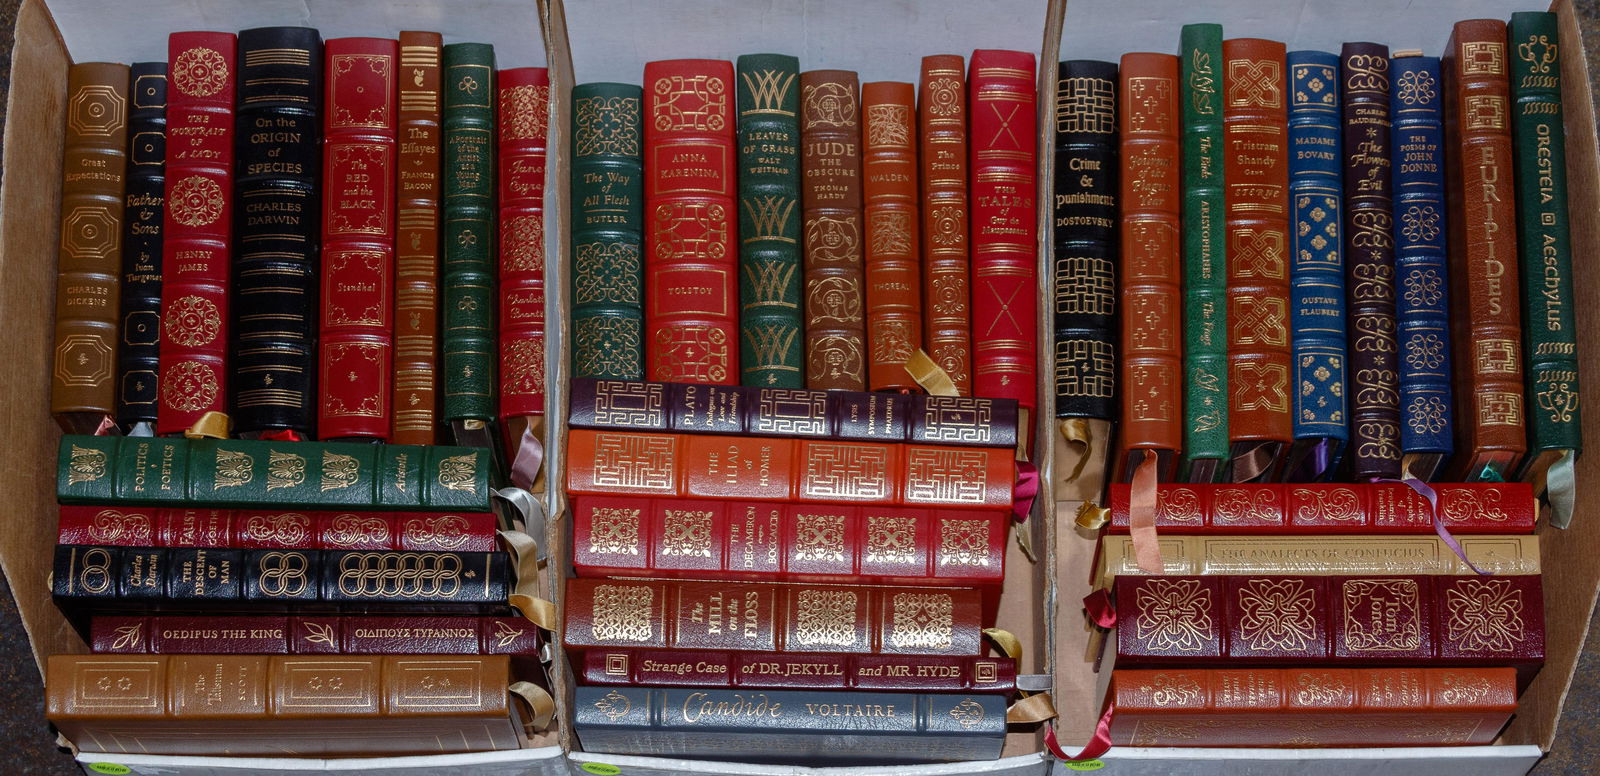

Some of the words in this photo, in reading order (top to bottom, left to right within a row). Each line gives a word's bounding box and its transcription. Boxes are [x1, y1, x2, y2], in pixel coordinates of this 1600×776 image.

[188, 115, 209, 123] THE
[1356, 109, 1387, 117] CHARLES
[256, 118, 272, 127] On
[277, 118, 296, 127] the
[171, 128, 226, 136] PORTRAIT
[251, 133, 301, 143] ORIGIN
[408, 128, 428, 139] The
[749, 132, 788, 141] LEAVES
[191, 138, 203, 146] OF
[1200, 136, 1212, 154] The
[1232, 140, 1278, 152] Tristram
[1358, 141, 1382, 153] The
[176, 150, 186, 158] A
[190, 150, 222, 159] LADY
[268, 148, 281, 157] of
[743, 145, 756, 154] OF
[762, 145, 796, 154] GRASS
[806, 143, 855, 157] JUDE
[937, 151, 954, 159] The
[672, 154, 707, 163] ANNA
[1237, 155, 1276, 167] Shandy
[1297, 152, 1335, 160] BOVARY
[1350, 153, 1390, 167] Flowers
[1404, 153, 1432, 162] JOHN
[82, 158, 106, 168] Great
[248, 163, 302, 174] SPECIES
[352, 159, 367, 170] The
[509, 160, 544, 174] Jane
[932, 162, 960, 170] Prince
[1069, 157, 1101, 171] Crime
[1200, 156, 1213, 179] Birds
[1401, 164, 1437, 173] DONNE
[1536, 123, 1553, 204] ORESTEIA
[66, 172, 121, 183] Expectations
[346, 174, 369, 182] RED
[401, 171, 435, 179] FRANCIS
[584, 172, 602, 184] The
[608, 172, 630, 184] Way
[661, 168, 719, 178] KARENINA
[807, 169, 855, 177] OBSCURE
[870, 174, 909, 182] WALDEN
[1368, 167, 1380, 180] of
[404, 182, 432, 190] BACON
[509, 176, 544, 195] Eyre
[1080, 174, 1093, 187] &
[1358, 179, 1382, 191] Evil
[344, 185, 359, 195] and
[361, 185, 373, 195] the
[601, 182, 612, 193] of
[1234, 188, 1280, 199] STERNE
[126, 192, 165, 207] Father
[340, 200, 376, 209] BLACK
[583, 196, 599, 206] All
[604, 195, 630, 206] Flesh
[978, 196, 1031, 208] TALES
[246, 203, 301, 212] CHARLES
[1001, 207, 1009, 216] of
[248, 216, 299, 226] DARWIN
[586, 216, 627, 224] BUTLER
[991, 216, 1007, 225] Guy
[1057, 217, 1113, 228] DOSTOEVSKY
[132, 222, 159, 235] Sons
[1479, 147, 1504, 316] EURIPIDES
[1201, 200, 1211, 280] ARISTOPHANES
[141, 252, 149, 262] by
[176, 250, 212, 259] HENRY
[178, 264, 208, 274] JAMES
[67, 286, 108, 295] CHARLES
[338, 282, 375, 292] Stendhal
[668, 287, 713, 295] TOLSTOY
[873, 282, 911, 290] THOREAU
[66, 298, 106, 306] DICKENS
[1203, 301, 1214, 319] The
[1201, 320, 1216, 346] Frogs
[684, 386, 696, 425] PLATO
[707, 396, 716, 426] Dialogues
[868, 396, 876, 435] SYMPOSIUM
[135, 442, 149, 492] POLITICS
[162, 444, 174, 490] POETICS
[709, 452, 719, 475] THE
[726, 445, 738, 484] ILIAD
[744, 459, 752, 470] of
[760, 446, 770, 487] HOMER
[396, 453, 408, 492] Aristotle
[180, 510, 196, 545] FAUST
[209, 511, 219, 545] GOETHE
[731, 523, 740, 544] THE
[744, 506, 756, 568] DECAMERON
[769, 510, 778, 564] BOCCACCIO
[1251, 549, 1317, 558] ANALECTS
[1323, 549, 1337, 558] OF
[1345, 548, 1424, 558] CONFUCIUS
[132, 554, 143, 587] Charles
[146, 554, 158, 587] Darwin
[183, 561, 192, 582] THE
[195, 550, 206, 596] DESCENT
[208, 565, 217, 578] OF
[221, 560, 230, 584] MAN
[692, 602, 703, 623] The
[728, 598, 738, 615] the
[709, 592, 722, 635] MILL
[745, 591, 758, 639] FLOSS
[1370, 595, 1384, 636] Jones
[1386, 597, 1400, 632] Tom
[729, 617, 738, 631] on
[164, 630, 217, 639] OEDIPUS
[221, 630, 247, 638] THE
[250, 629, 282, 639] KING
[355, 629, 411, 638] ΟΙΔΙΠΟΥΣ
[413, 629, 475, 638] ΤΥΡΑΝΝΟΣ
[642, 660, 692, 674] Strange
[696, 662, 726, 673] Case
[742, 662, 757, 674] of
[759, 663, 783, 674] DR.
[785, 664, 845, 676] JEKYLL
[859, 666, 882, 676] and
[887, 666, 913, 677] MR.
[917, 666, 960, 677] HYDE
[195, 674, 205, 694] The
[208, 663, 223, 705] Talisman
[683, 692, 783, 723] Candide
[806, 704, 895, 718] VOLTAIRE
